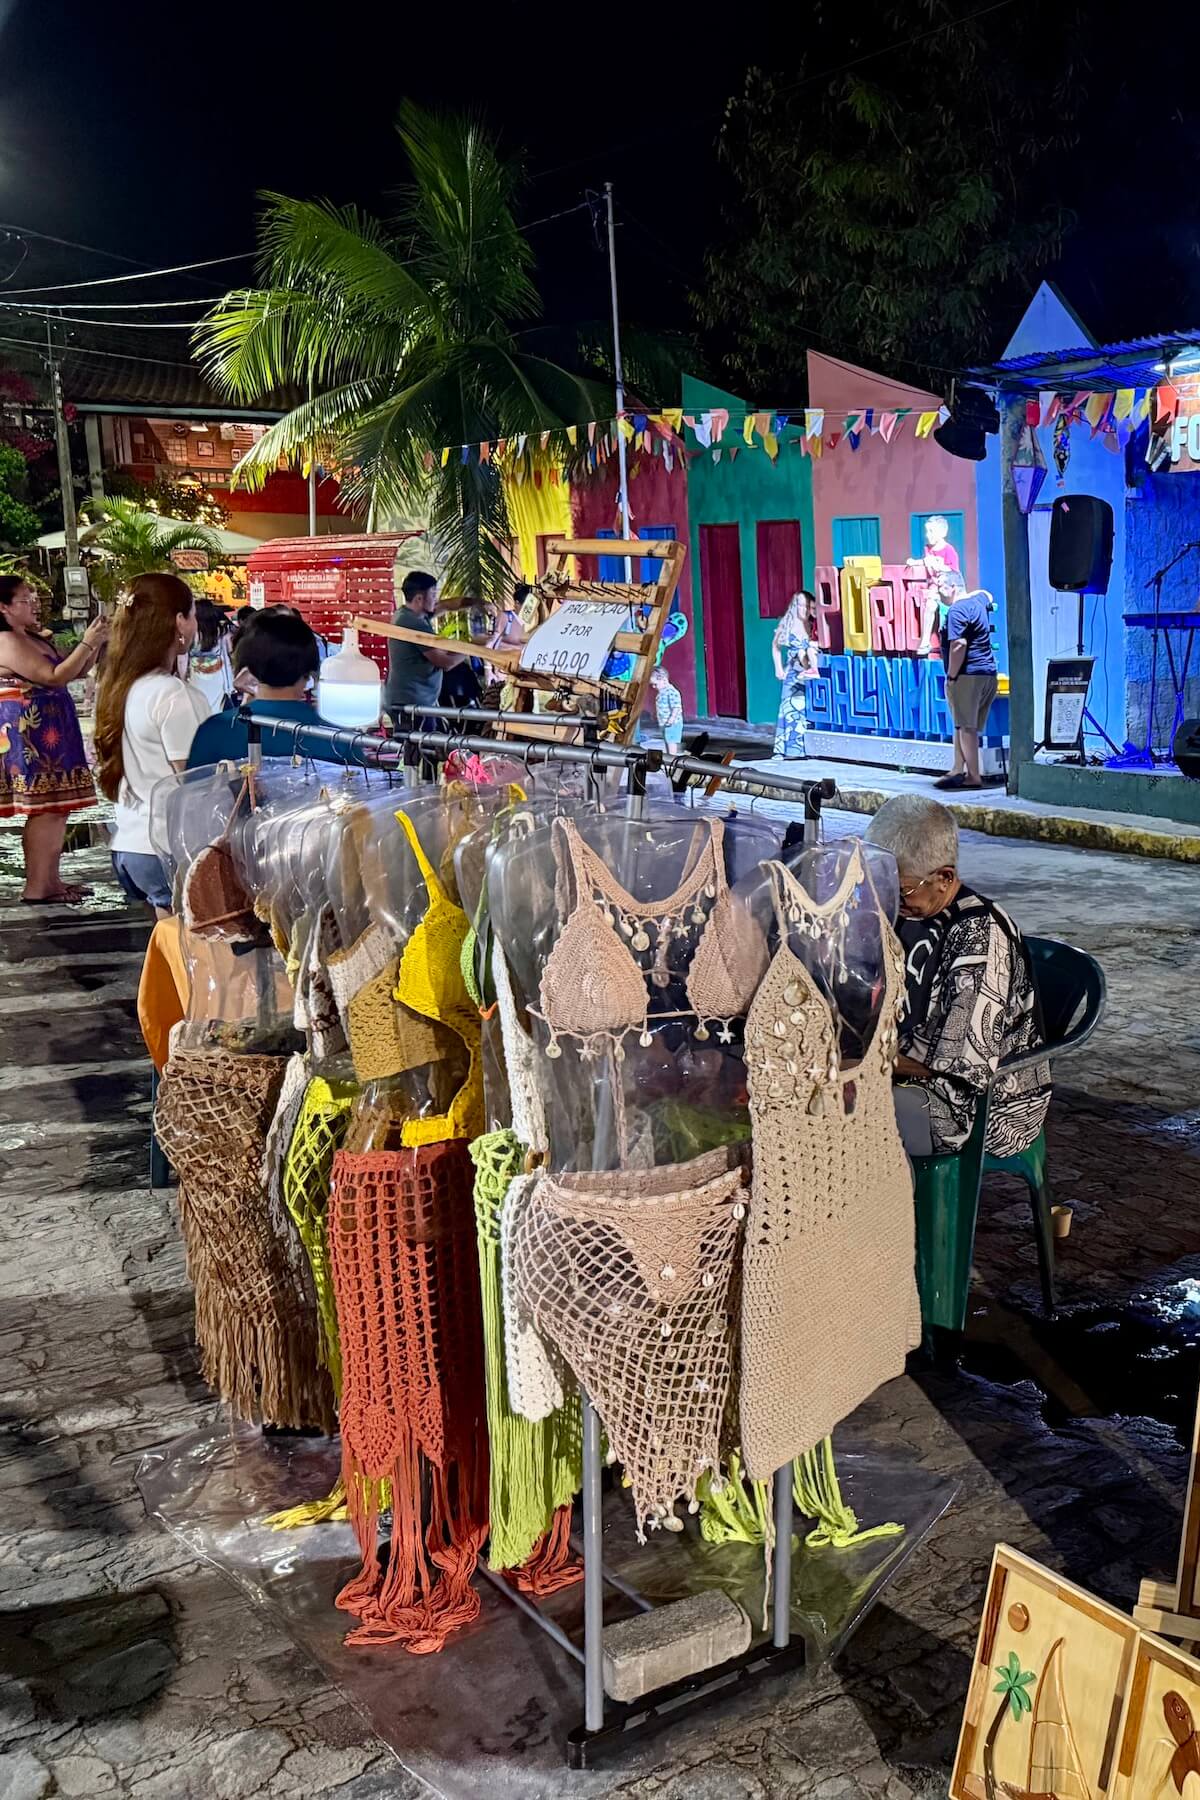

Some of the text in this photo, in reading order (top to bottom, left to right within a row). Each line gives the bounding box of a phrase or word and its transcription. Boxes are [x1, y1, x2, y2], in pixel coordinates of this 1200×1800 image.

[560, 623, 593, 638] 3 POR
[814, 564, 942, 653] PORTO
[535, 649, 590, 671] R$ 10,00
[805, 654, 955, 736] GALINHA
